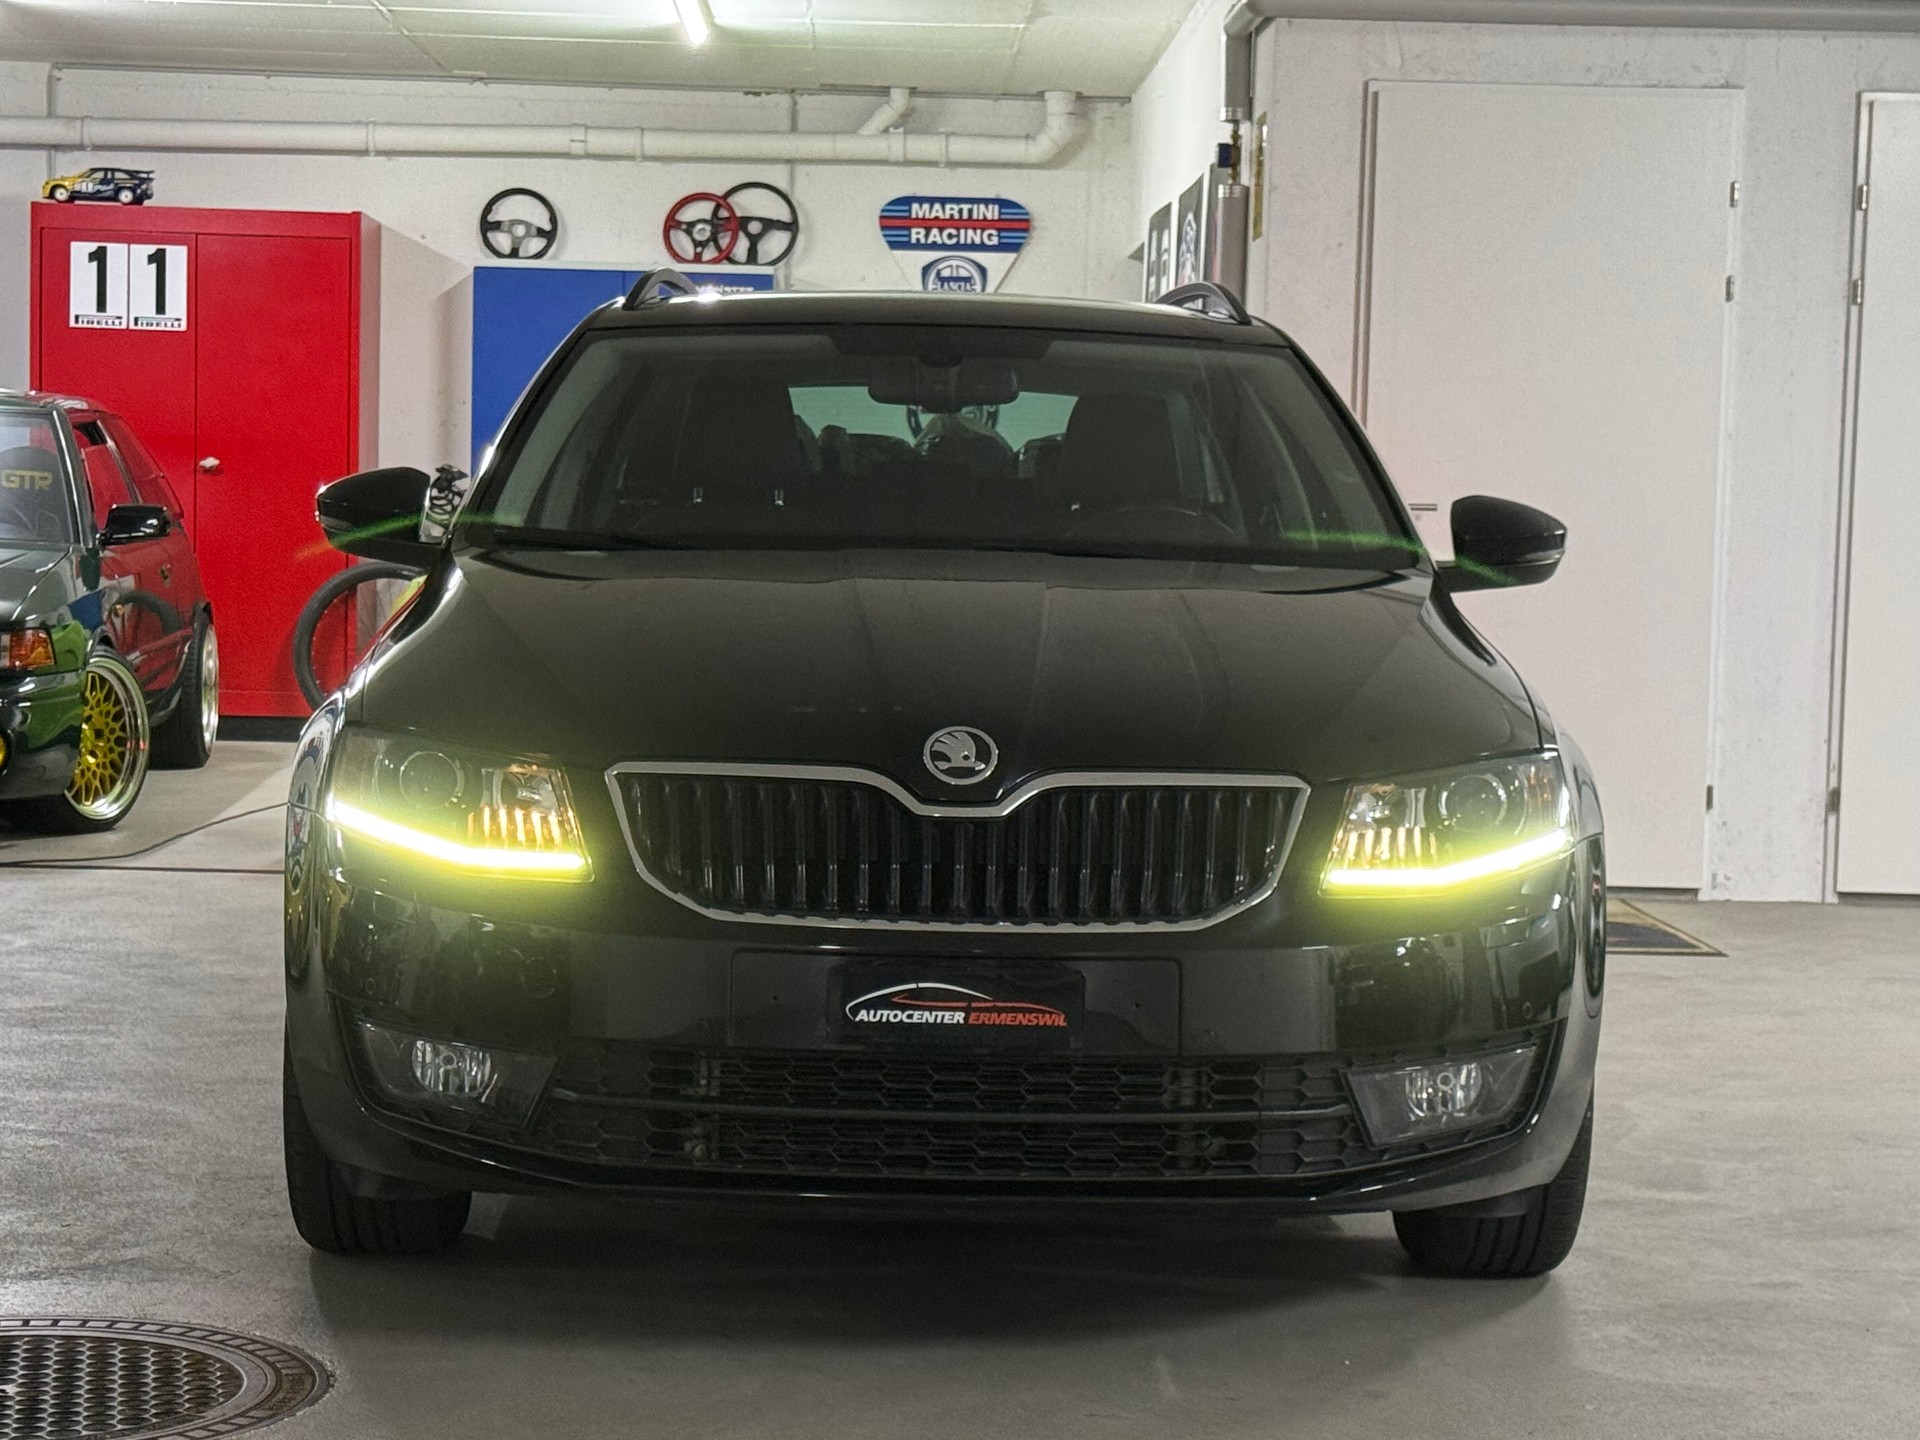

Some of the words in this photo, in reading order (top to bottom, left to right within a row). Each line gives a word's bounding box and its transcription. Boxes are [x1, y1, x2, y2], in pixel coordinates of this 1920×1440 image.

[911, 203, 999, 219] MARTINI
[911, 228, 999, 245] RACING
[1, 470, 53, 489] GTR
[855, 1009, 965, 1023] AUTOCENTER
[968, 1012, 1067, 1026] ERMENSWIL
